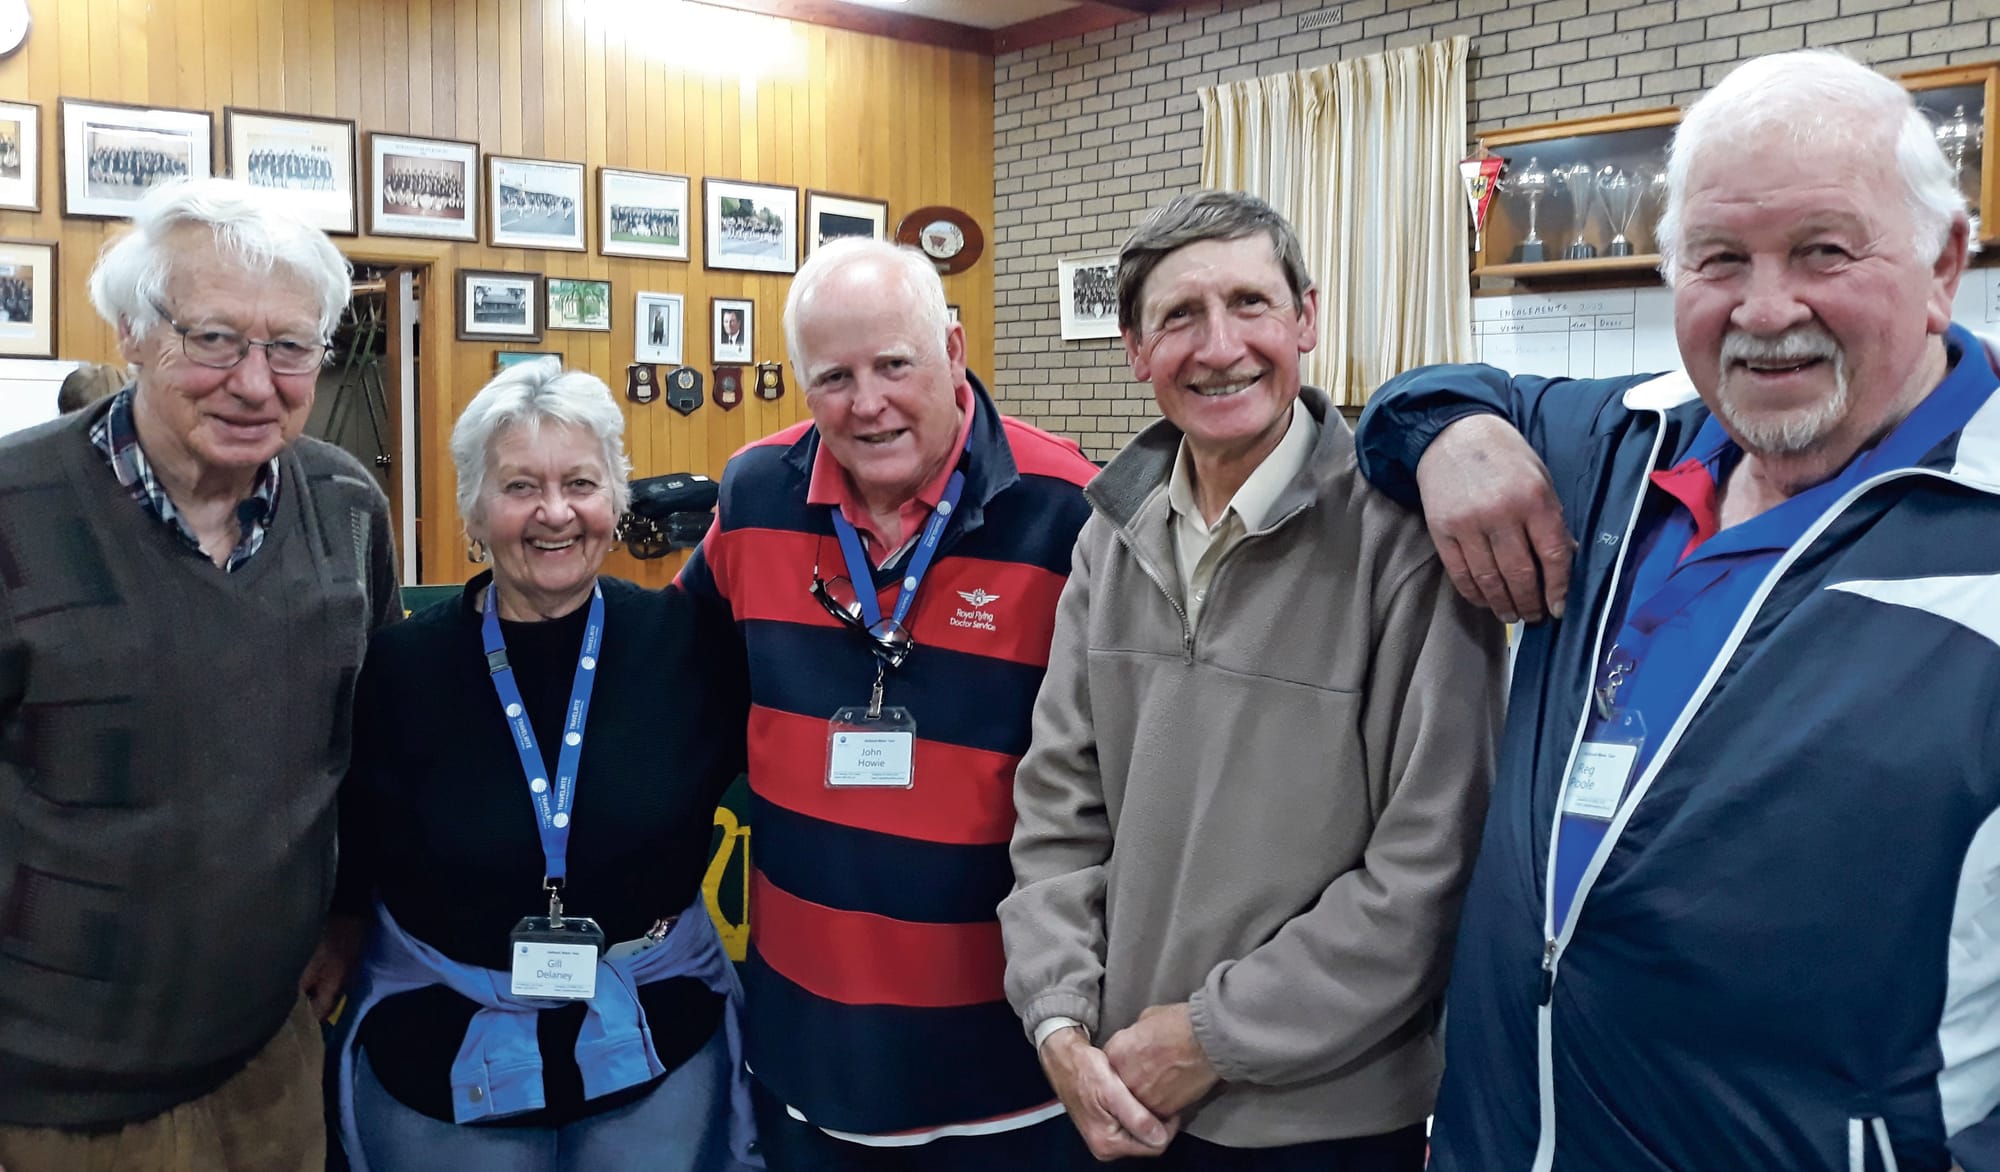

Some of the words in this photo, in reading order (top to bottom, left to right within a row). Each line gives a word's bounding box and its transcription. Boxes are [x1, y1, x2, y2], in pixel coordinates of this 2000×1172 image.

[956, 608, 975, 620] Royal
[975, 611, 994, 622] Flying
[950, 617, 972, 628] Doctor
[972, 620, 996, 631] Service
[569, 699, 581, 730] TRAVELRITE
[517, 718, 533, 749] TRAVELRITE
[861, 748, 882, 757] John
[857, 760, 885, 768] Howie
[1578, 763, 1595, 777] Reg
[557, 776, 568, 811] TRAVELRITE
[547, 959, 563, 968] Gill
[536, 969, 574, 982] Delaney
